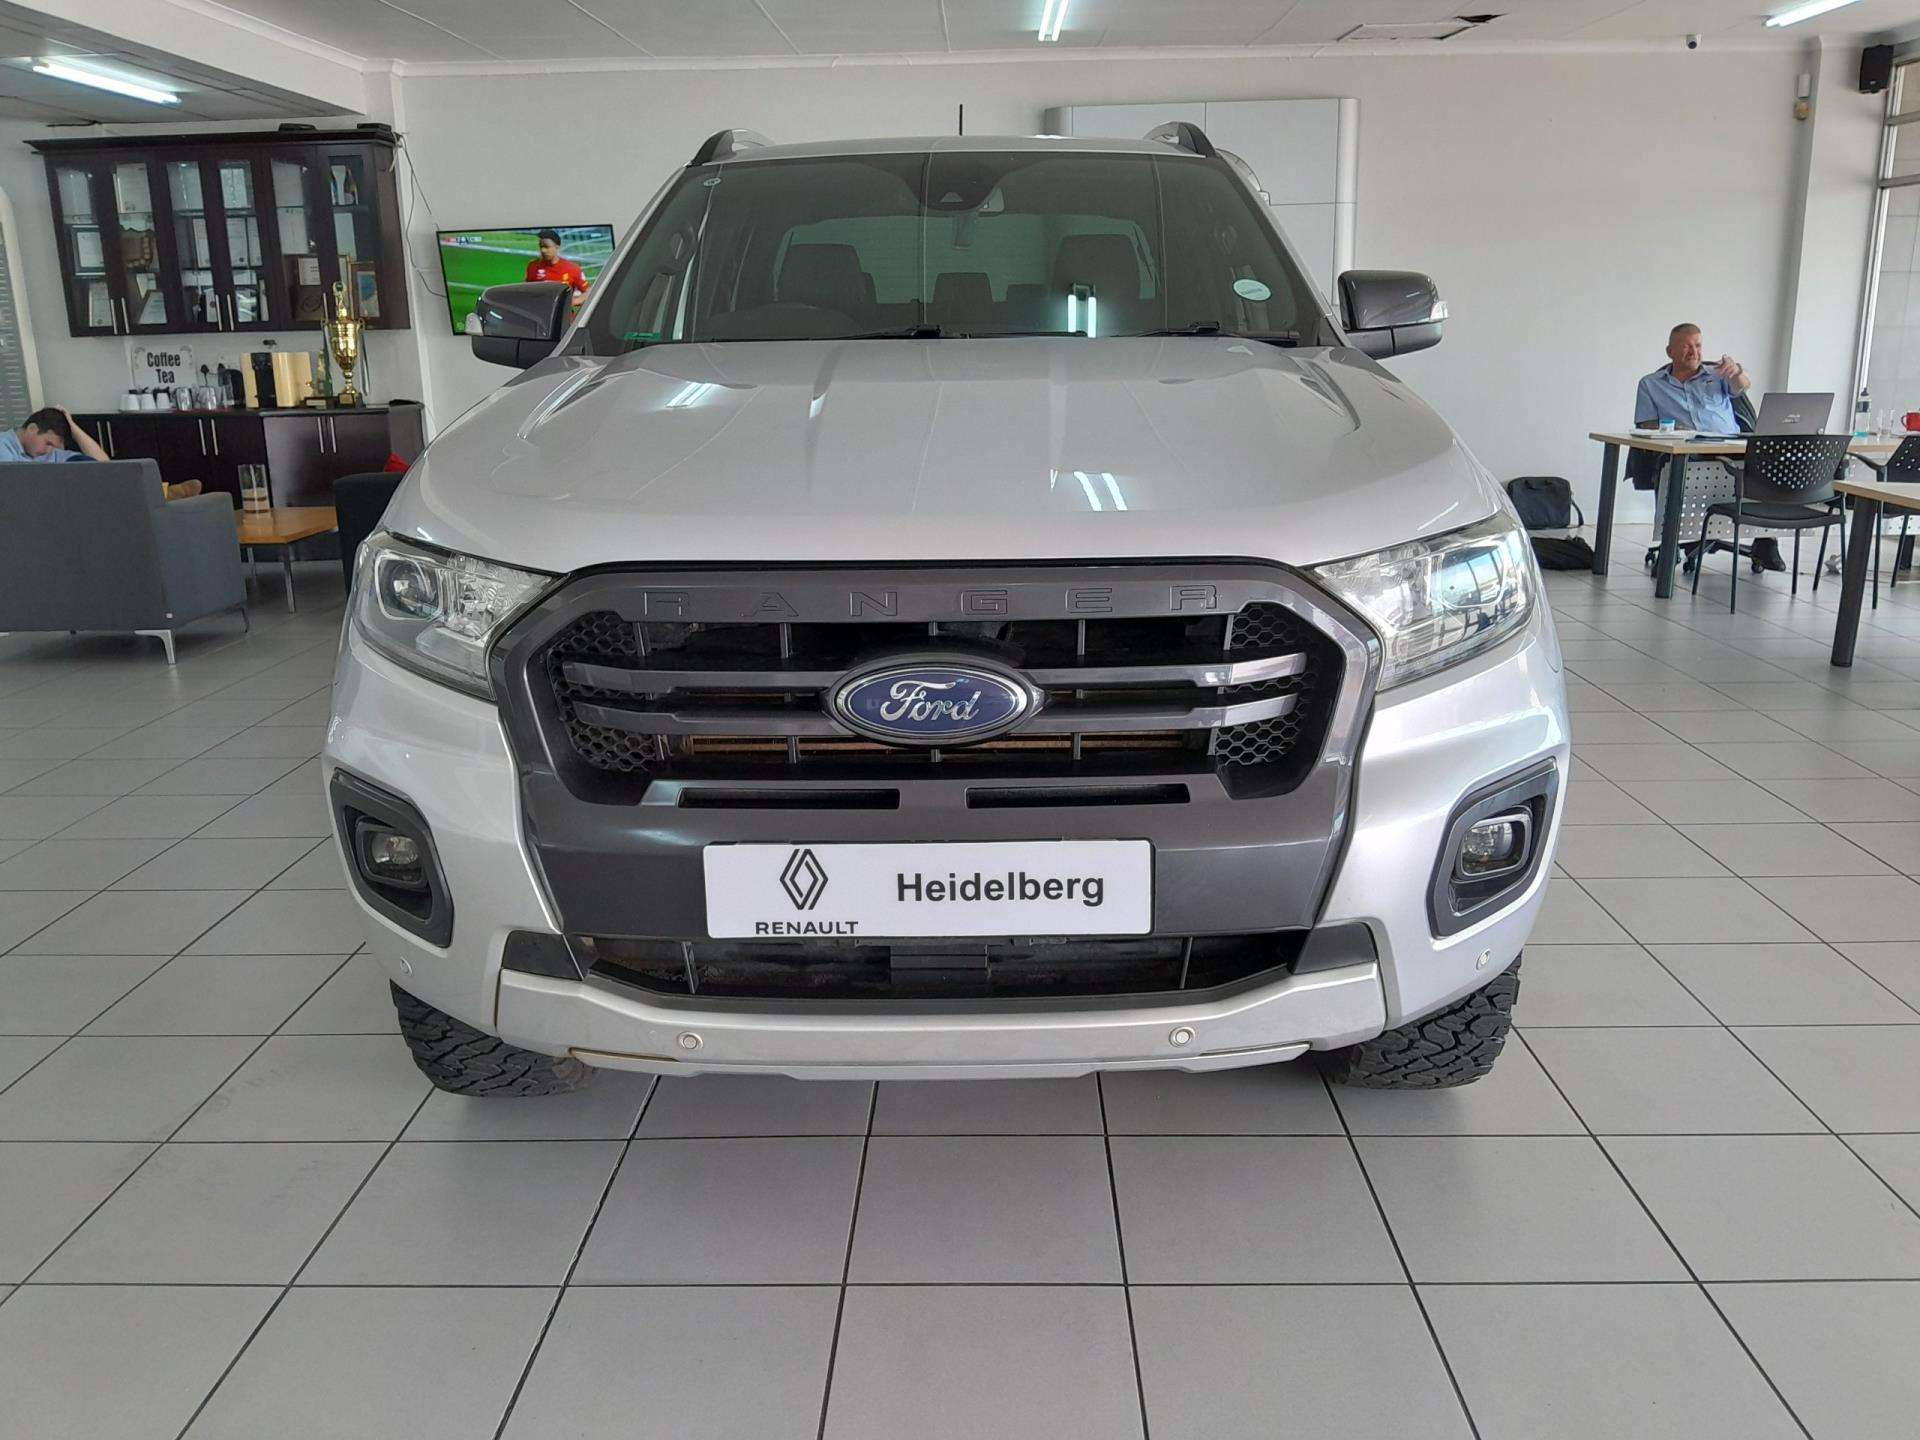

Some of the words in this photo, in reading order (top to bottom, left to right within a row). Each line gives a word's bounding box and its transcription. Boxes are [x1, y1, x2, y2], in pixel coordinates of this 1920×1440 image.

[147, 351, 181, 368] Coffee
[155, 369, 175, 384] Tea
[643, 584, 1218, 617] RANGER
[880, 680, 982, 721] Ford
[897, 871, 1105, 907] Heidelberg
[755, 920, 859, 935] RENAULT
